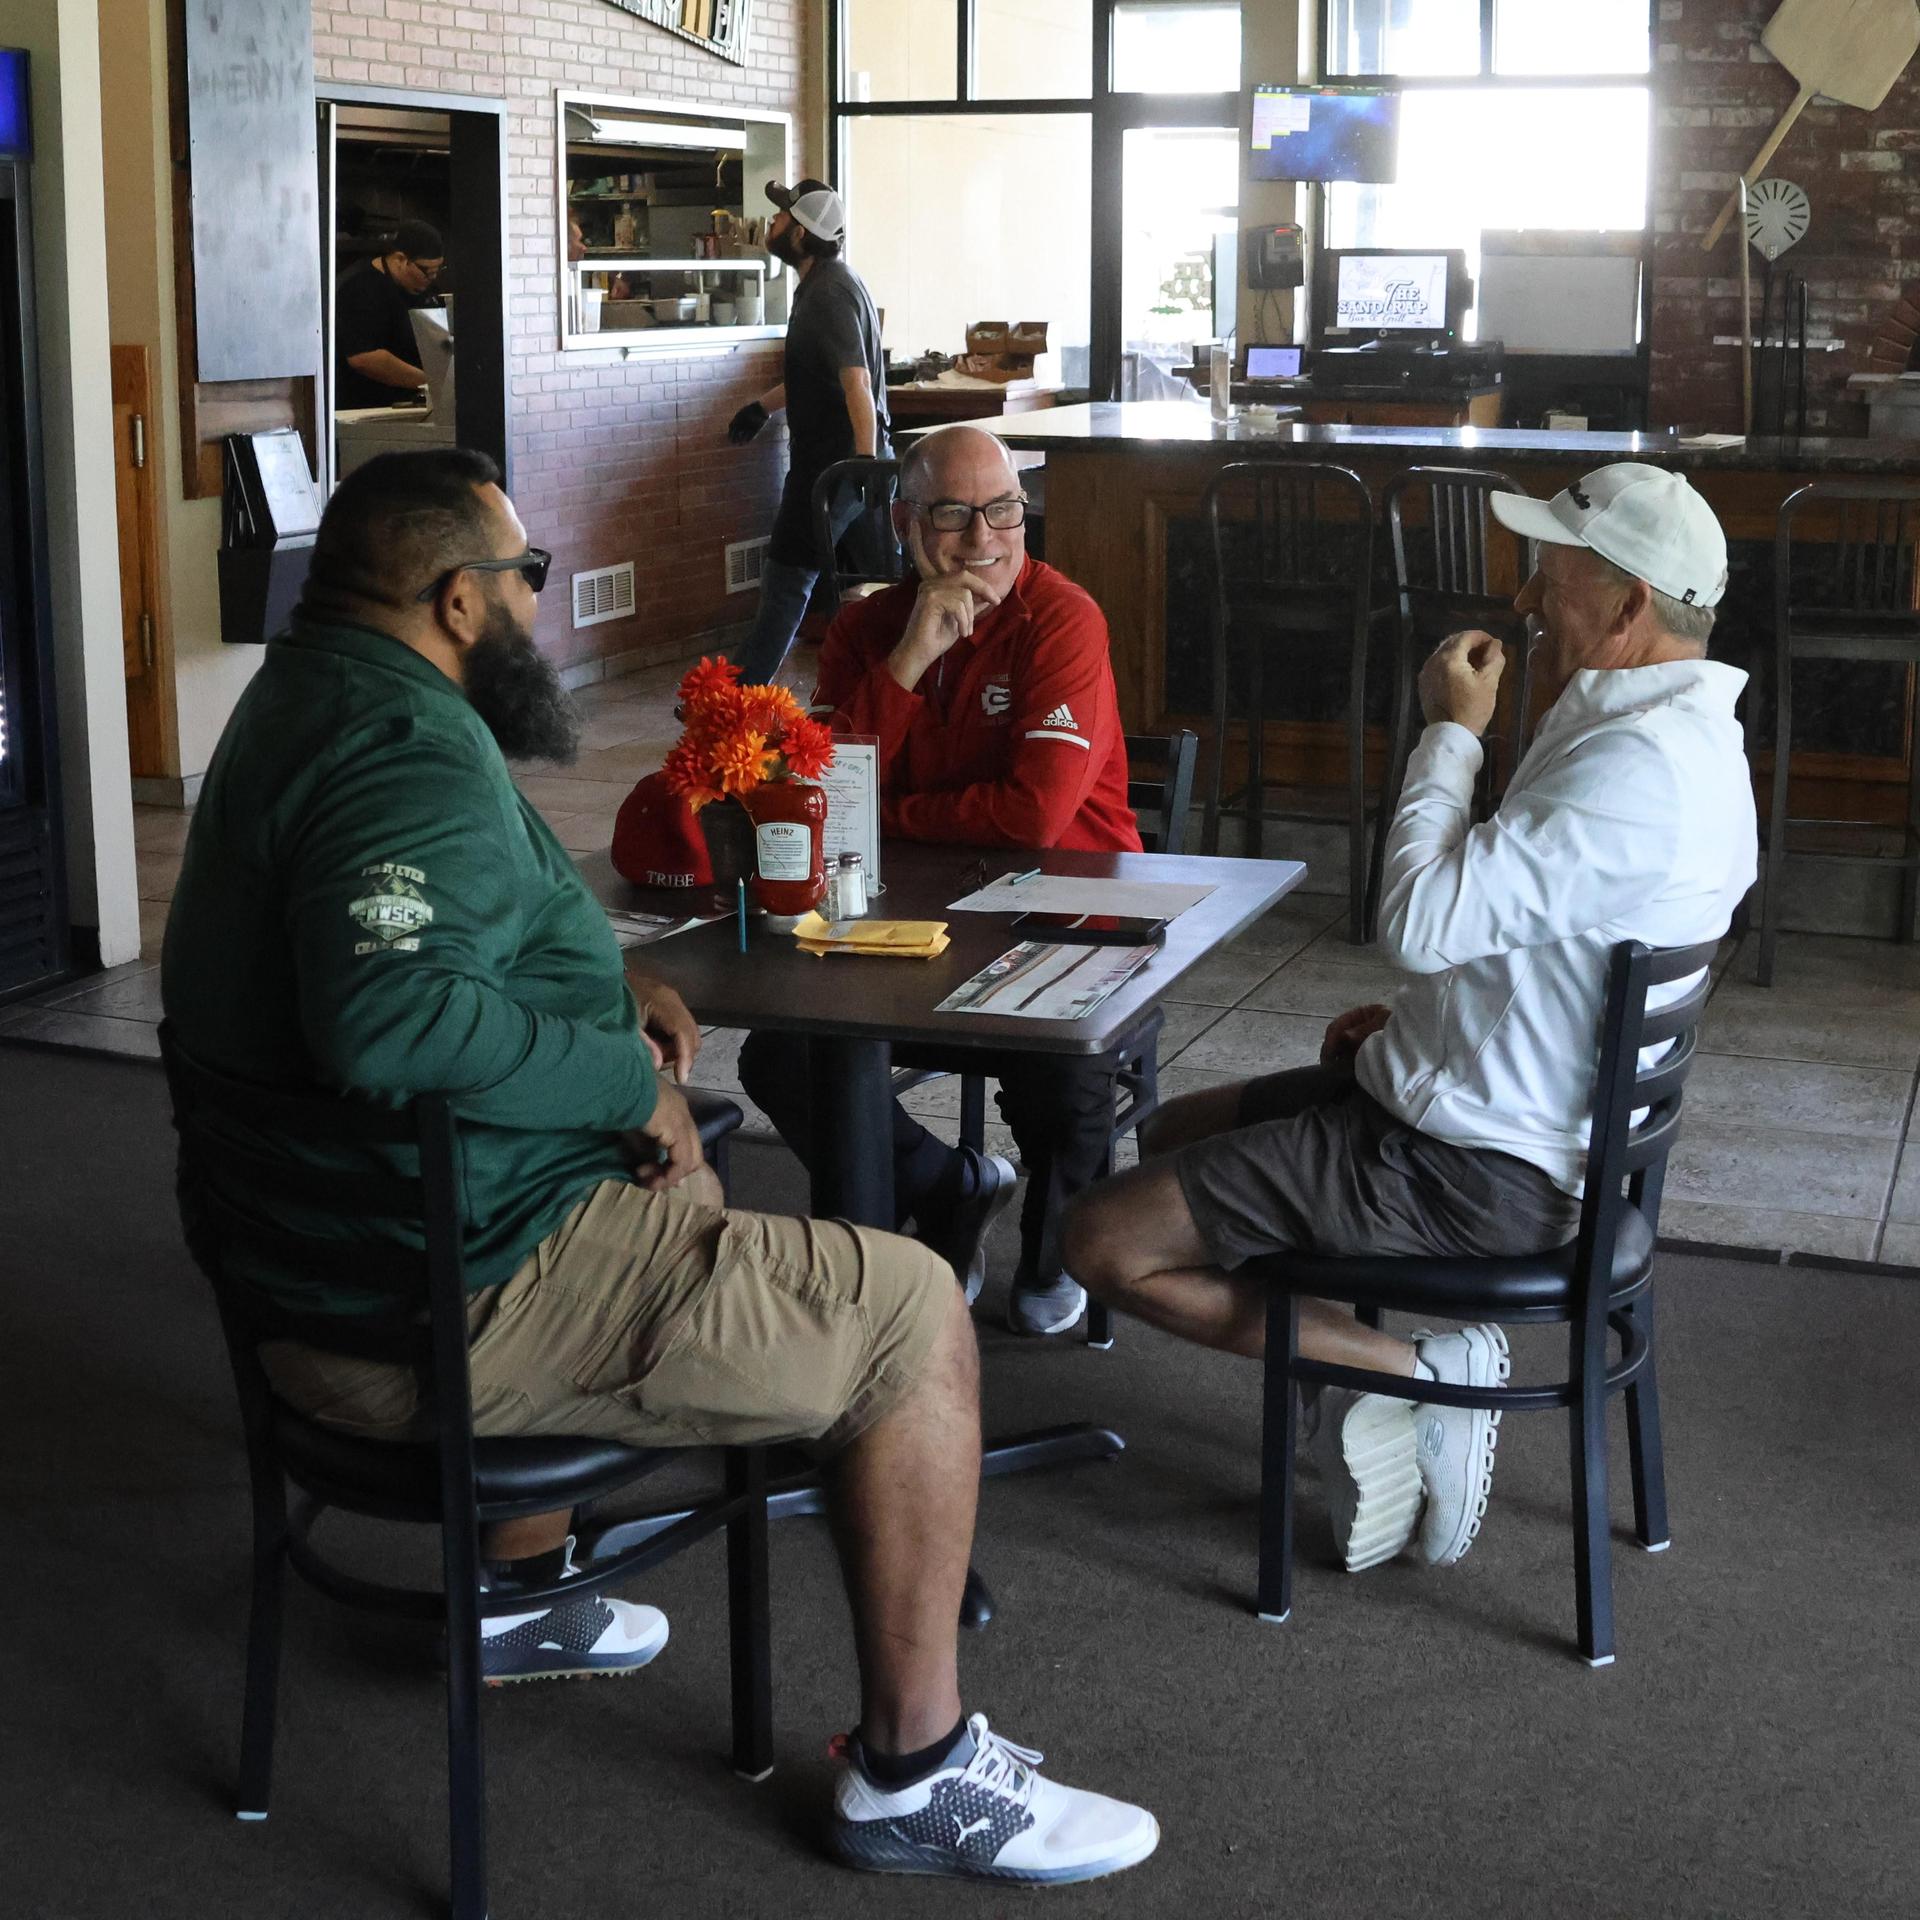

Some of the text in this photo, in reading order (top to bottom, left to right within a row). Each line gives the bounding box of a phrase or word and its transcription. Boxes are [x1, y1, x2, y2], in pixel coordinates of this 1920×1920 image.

[1043, 717, 1079, 730] adidas
[770, 827, 794, 837] HEINZ
[646, 870, 695, 887] TRIBE
[367, 905, 415, 924] NWSC
